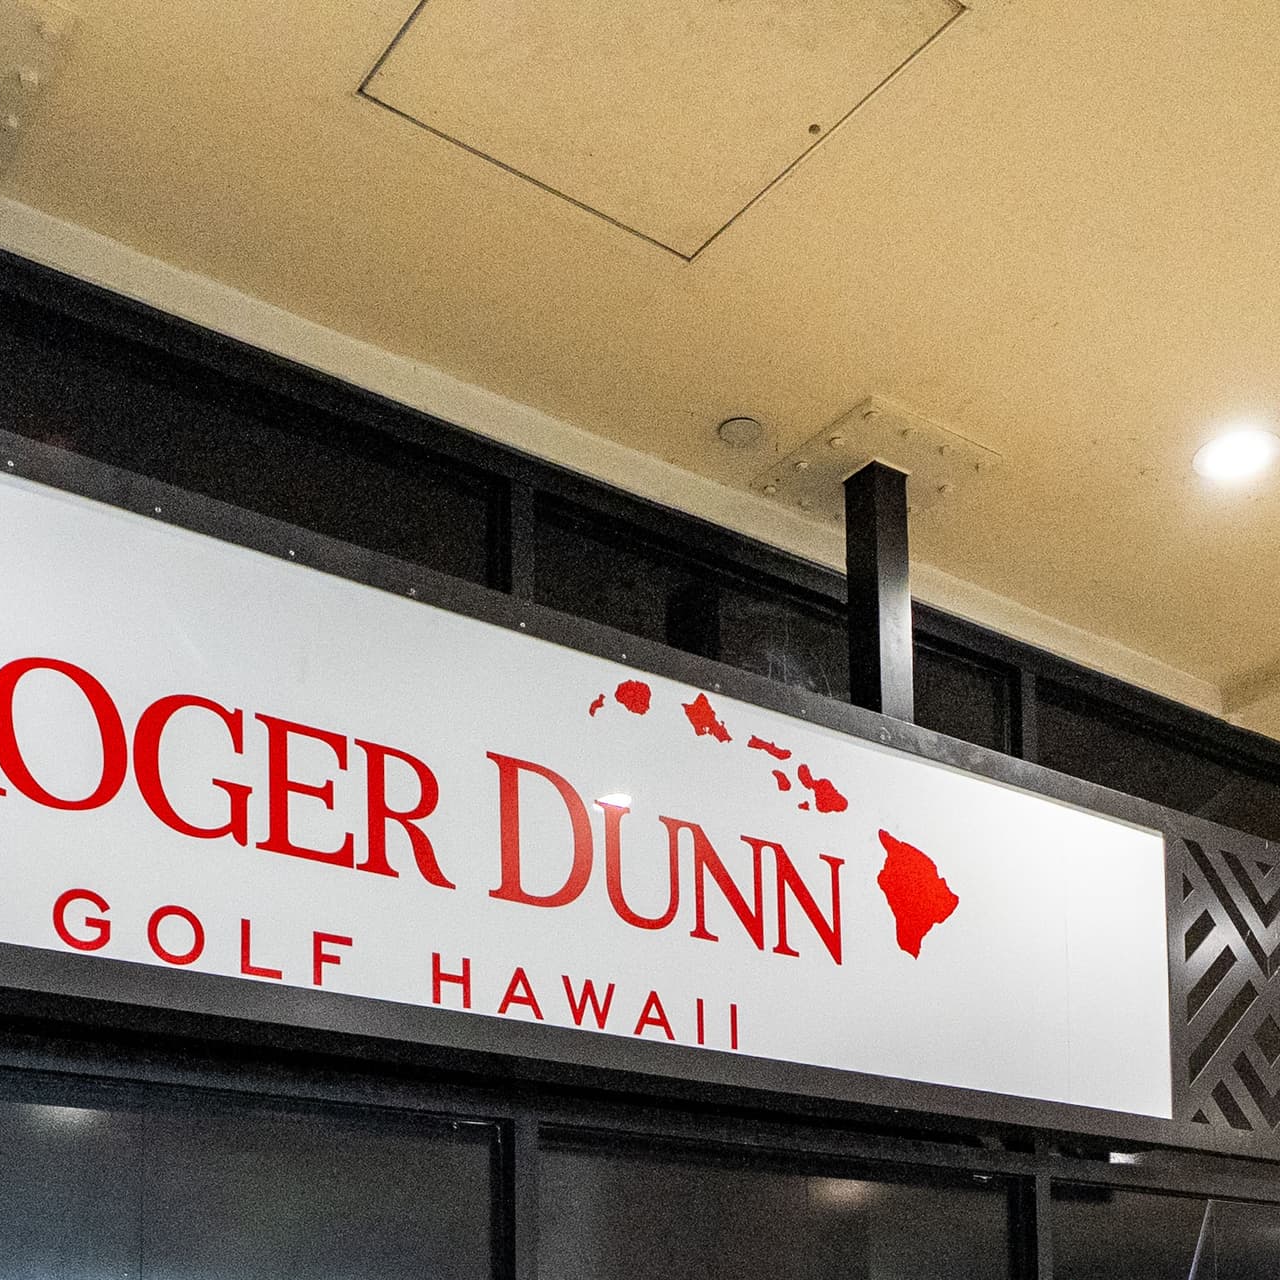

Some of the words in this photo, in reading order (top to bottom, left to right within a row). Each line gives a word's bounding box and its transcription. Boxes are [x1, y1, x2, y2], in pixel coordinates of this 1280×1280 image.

[486, 751, 845, 967] DUNN
[52, 887, 355, 987] GOLF
[431, 952, 740, 1050] HAWAII
